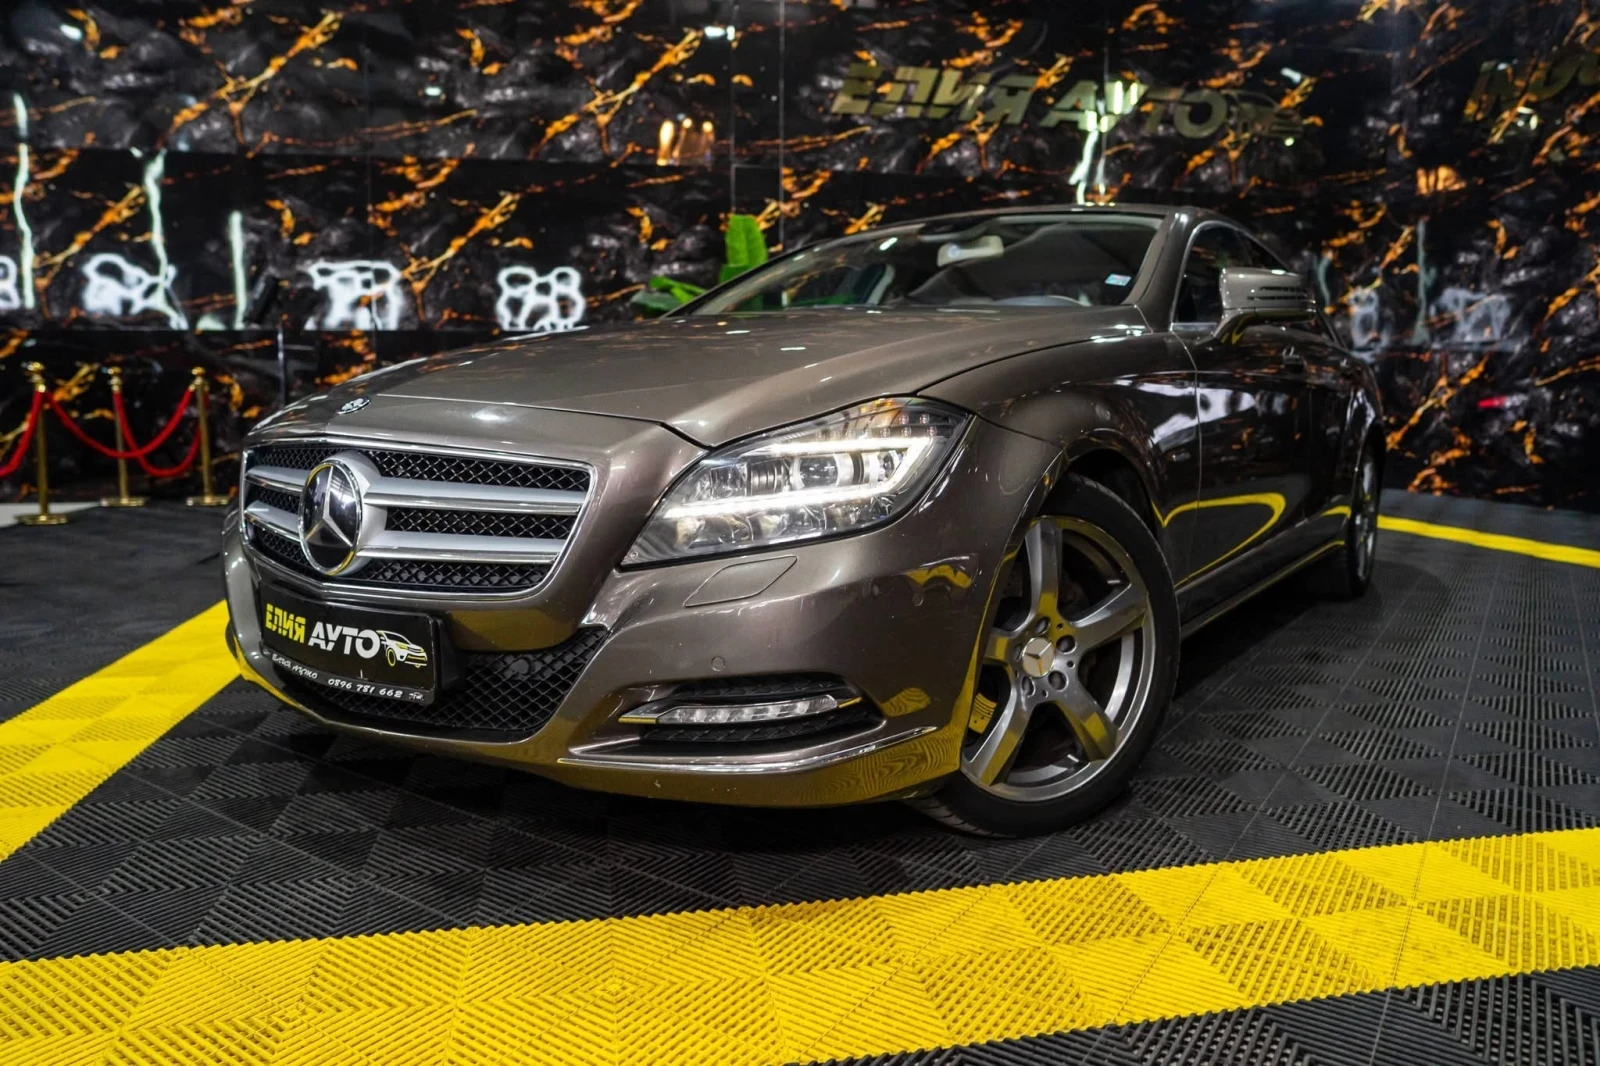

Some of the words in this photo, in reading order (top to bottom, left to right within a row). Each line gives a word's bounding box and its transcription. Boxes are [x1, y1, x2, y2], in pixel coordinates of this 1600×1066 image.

[264, 603, 307, 644] ЕЛИЯ
[308, 621, 381, 659] АУТО
[327, 678, 353, 690] 0896
[356, 684, 376, 694] 781
